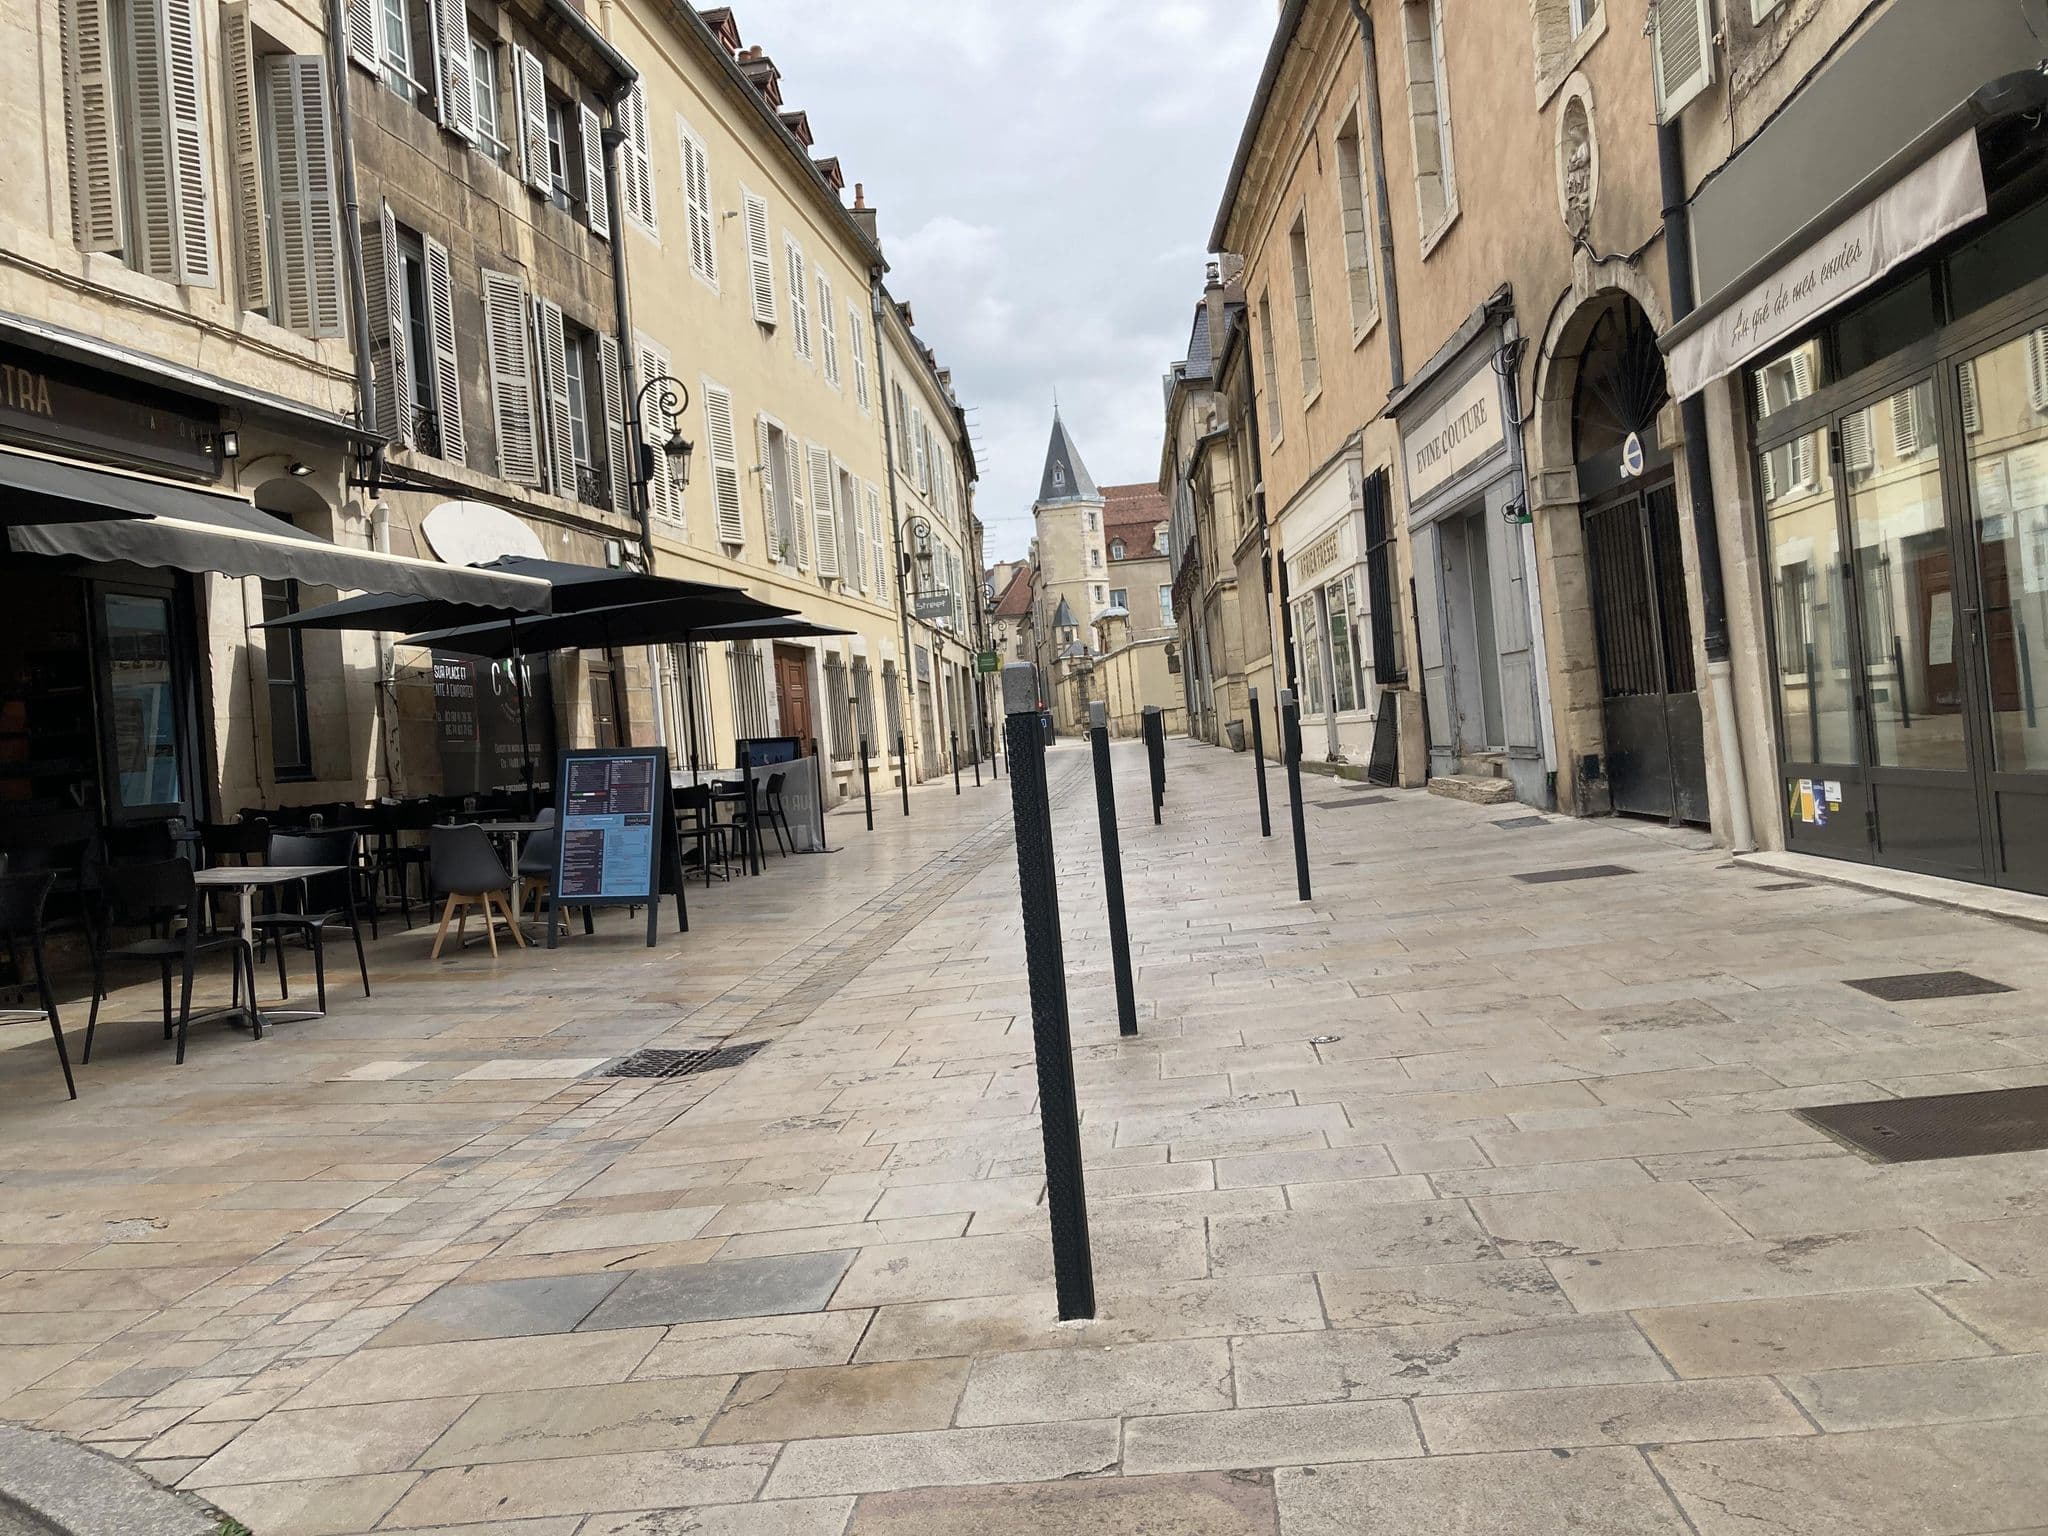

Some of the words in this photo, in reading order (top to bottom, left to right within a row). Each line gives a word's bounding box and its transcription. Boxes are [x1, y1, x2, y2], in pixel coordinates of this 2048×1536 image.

[1731, 308, 1750, 347] Au
[1752, 290, 1770, 342] gré
[1774, 283, 1789, 316] de
[1792, 270, 1817, 304] mes
[1820, 238, 1863, 285] envies
[0, 363, 54, 416] TRA
[1416, 435, 1442, 474] EVINE
[1442, 397, 1488, 455] COUTURE
